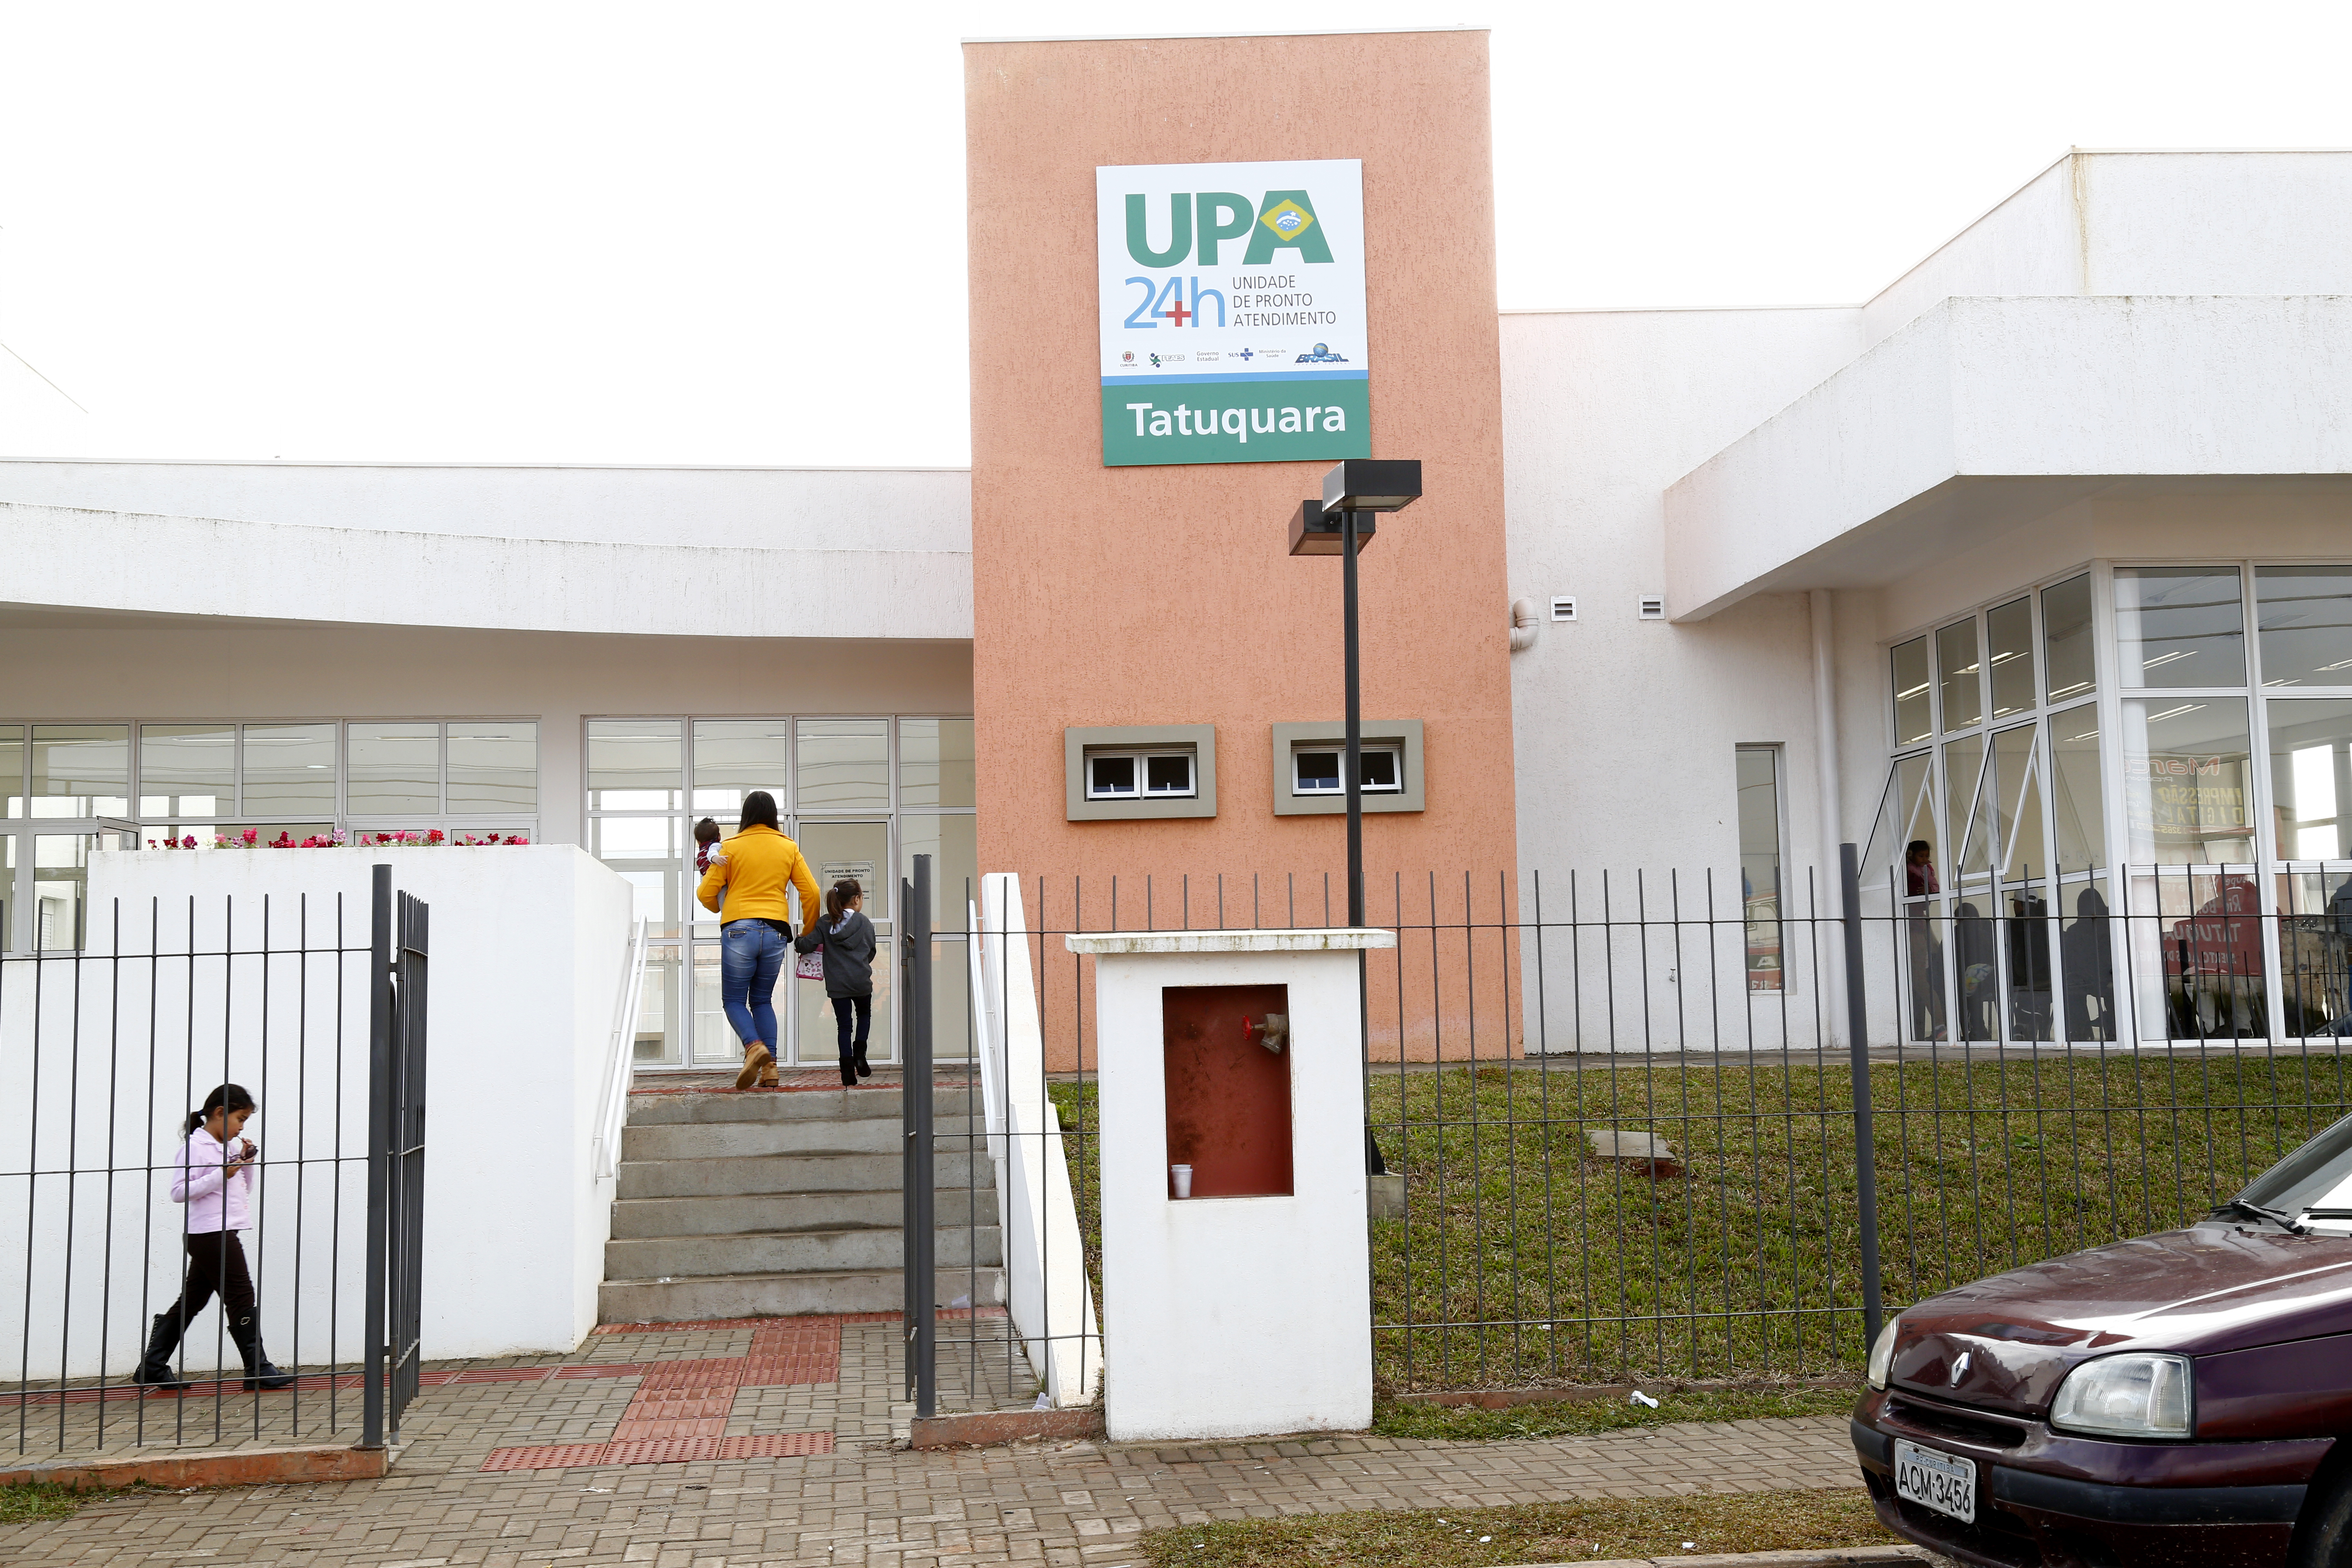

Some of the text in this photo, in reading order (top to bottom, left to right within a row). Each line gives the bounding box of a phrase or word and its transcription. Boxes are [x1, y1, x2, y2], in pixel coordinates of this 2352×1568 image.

[1125, 189, 1335, 268] UPA
[1232, 275, 1296, 290] UNIDADE
[1124, 276, 1225, 329] 24h
[1233, 293, 1313, 308] DE PRONTO
[1233, 310, 1336, 327] ATENDIMENTO
[1294, 353, 1350, 363] BRASIL
[1126, 402, 1346, 443] Tatuquara
[1915, 1455, 1955, 1474] PR-CURITIBA
